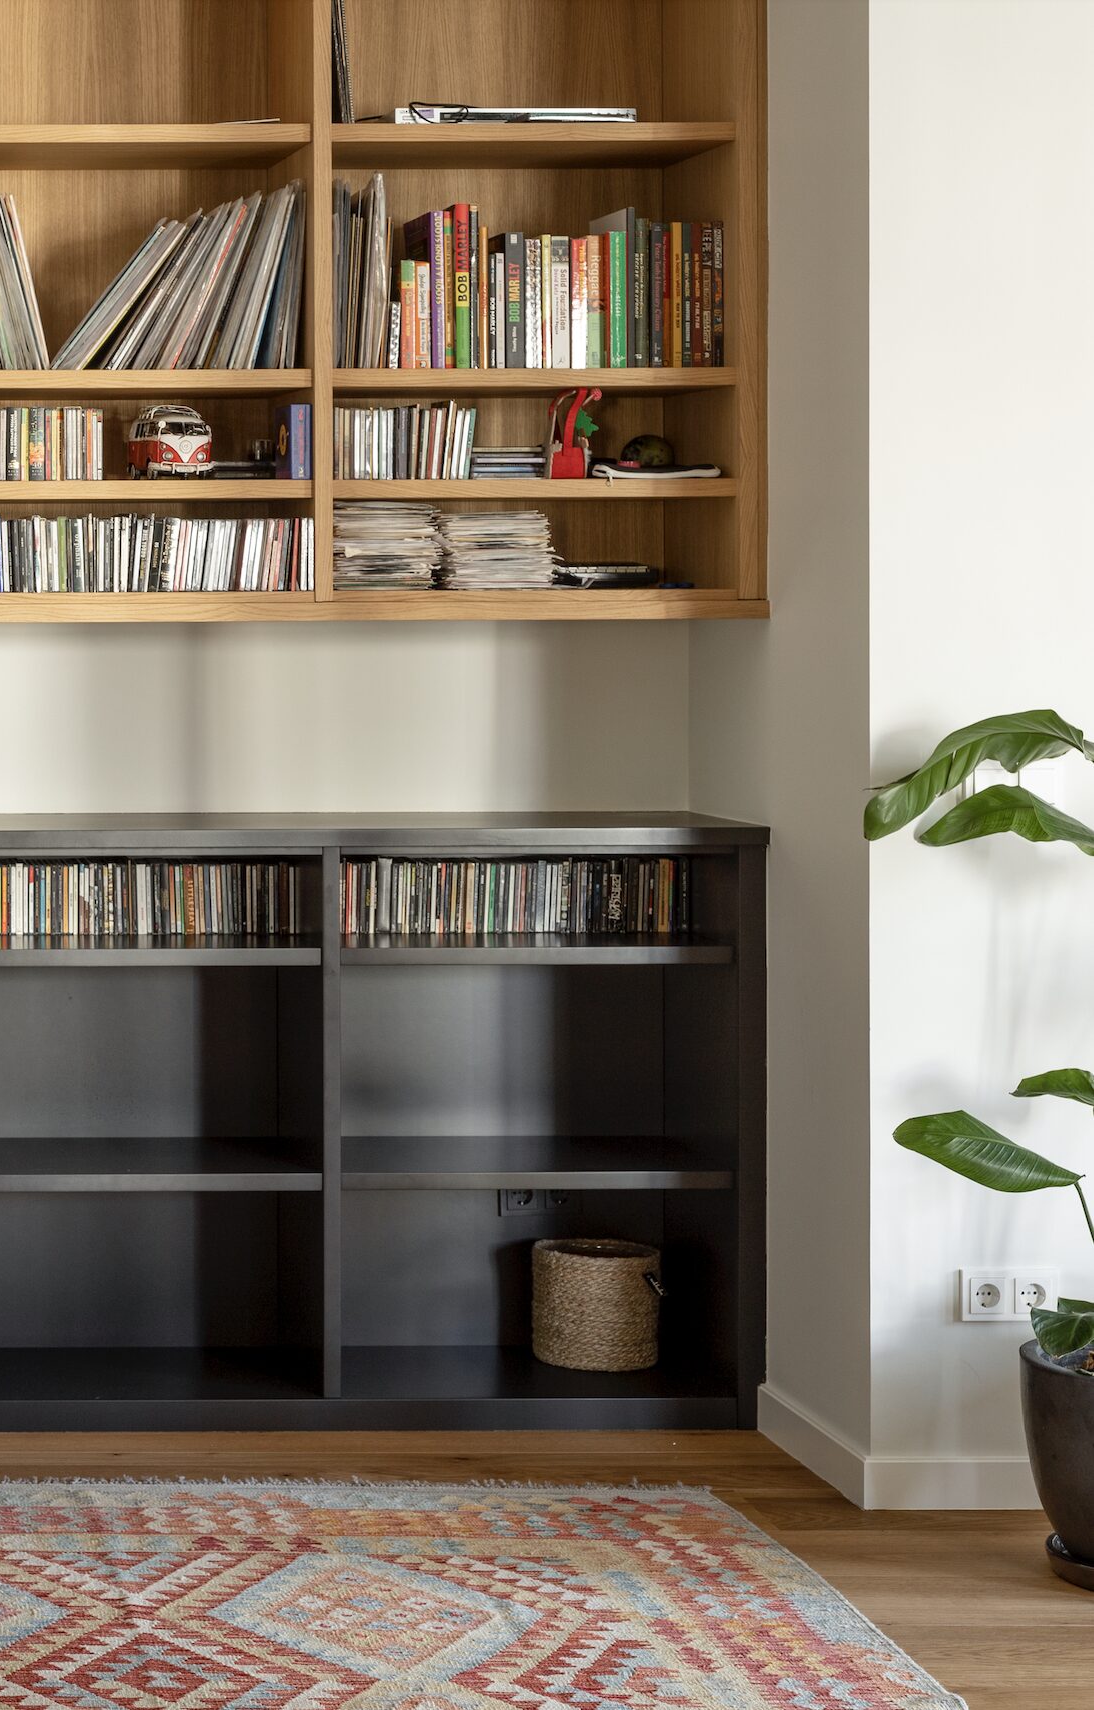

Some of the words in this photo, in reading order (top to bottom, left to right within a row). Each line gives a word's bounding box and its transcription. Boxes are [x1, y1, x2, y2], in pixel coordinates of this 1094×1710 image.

[457, 219, 468, 271] MARLEY
[458, 275, 468, 302] BOB
[509, 263, 520, 302] MARLEY
[588, 255, 601, 295] Reggae
[509, 302, 520, 323] BOB
